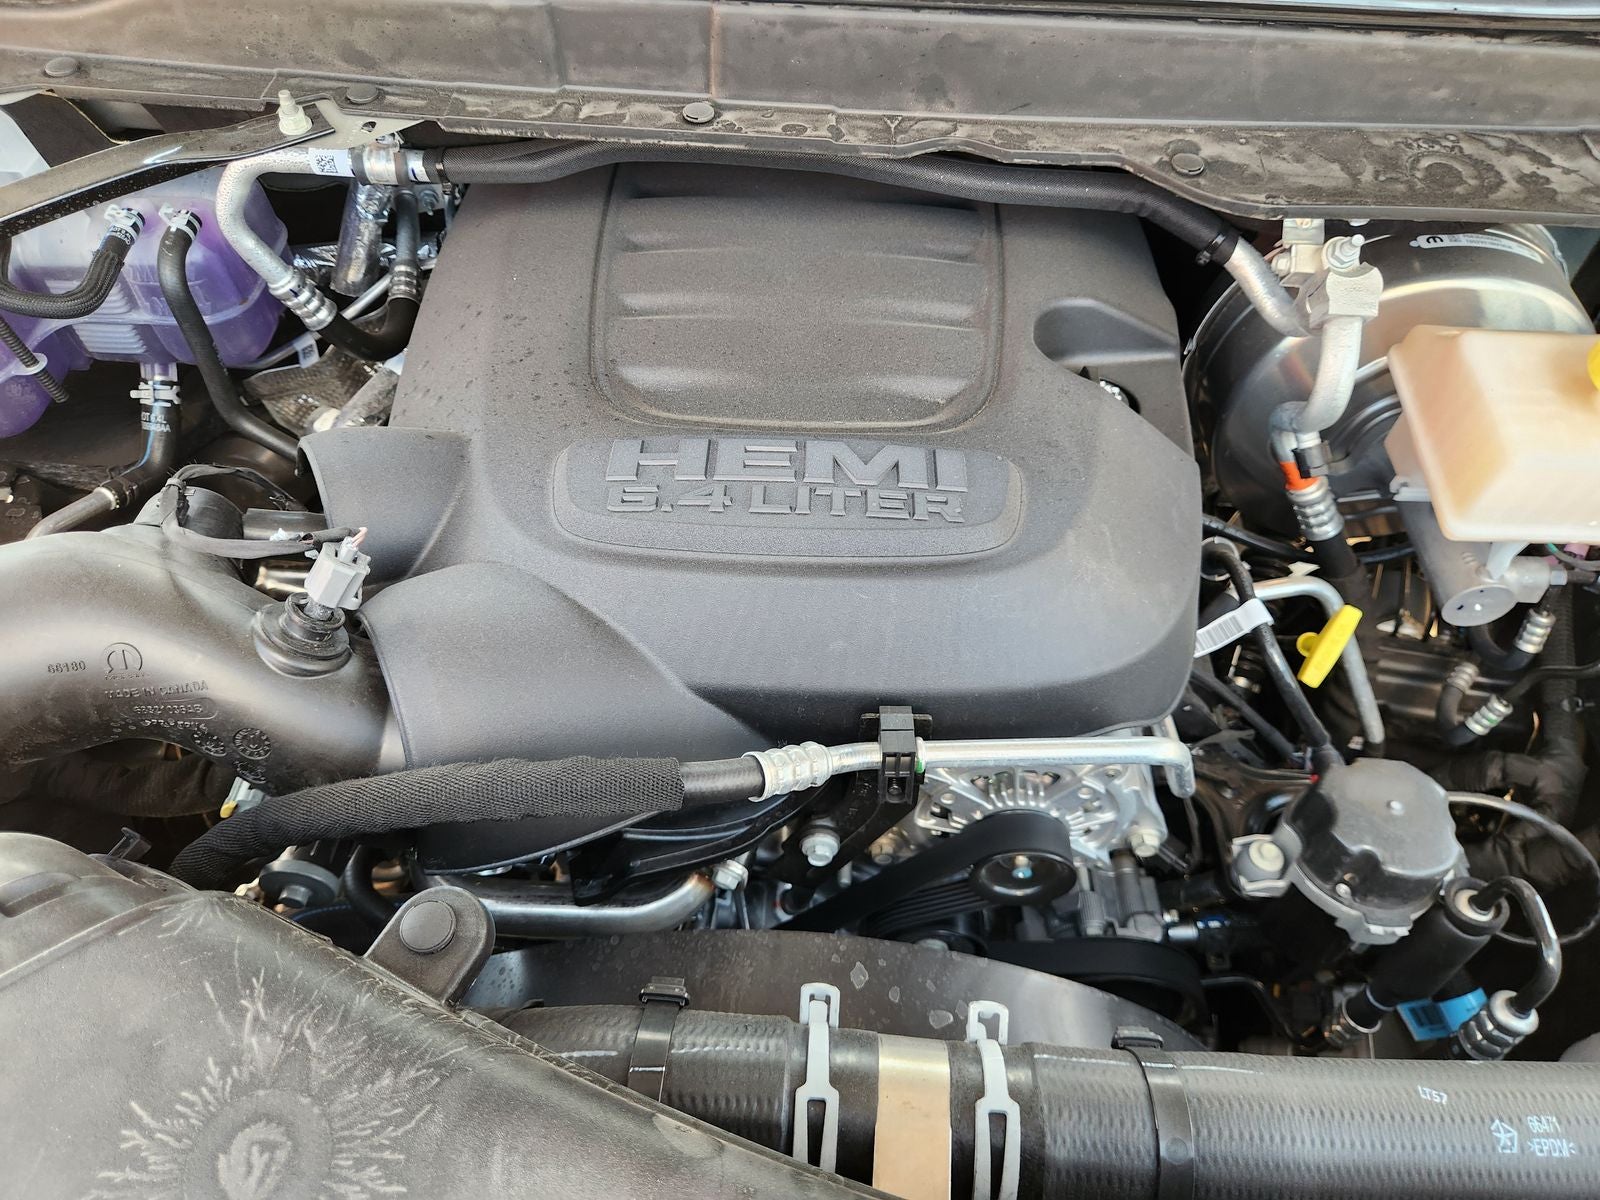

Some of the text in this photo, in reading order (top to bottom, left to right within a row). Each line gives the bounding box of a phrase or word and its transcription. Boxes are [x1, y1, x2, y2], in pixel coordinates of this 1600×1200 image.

[605, 438, 968, 493] HEMI
[606, 484, 965, 524] 6.4 LITER
[142, 686, 156, 697] IN
[160, 680, 209, 696] CANADA
